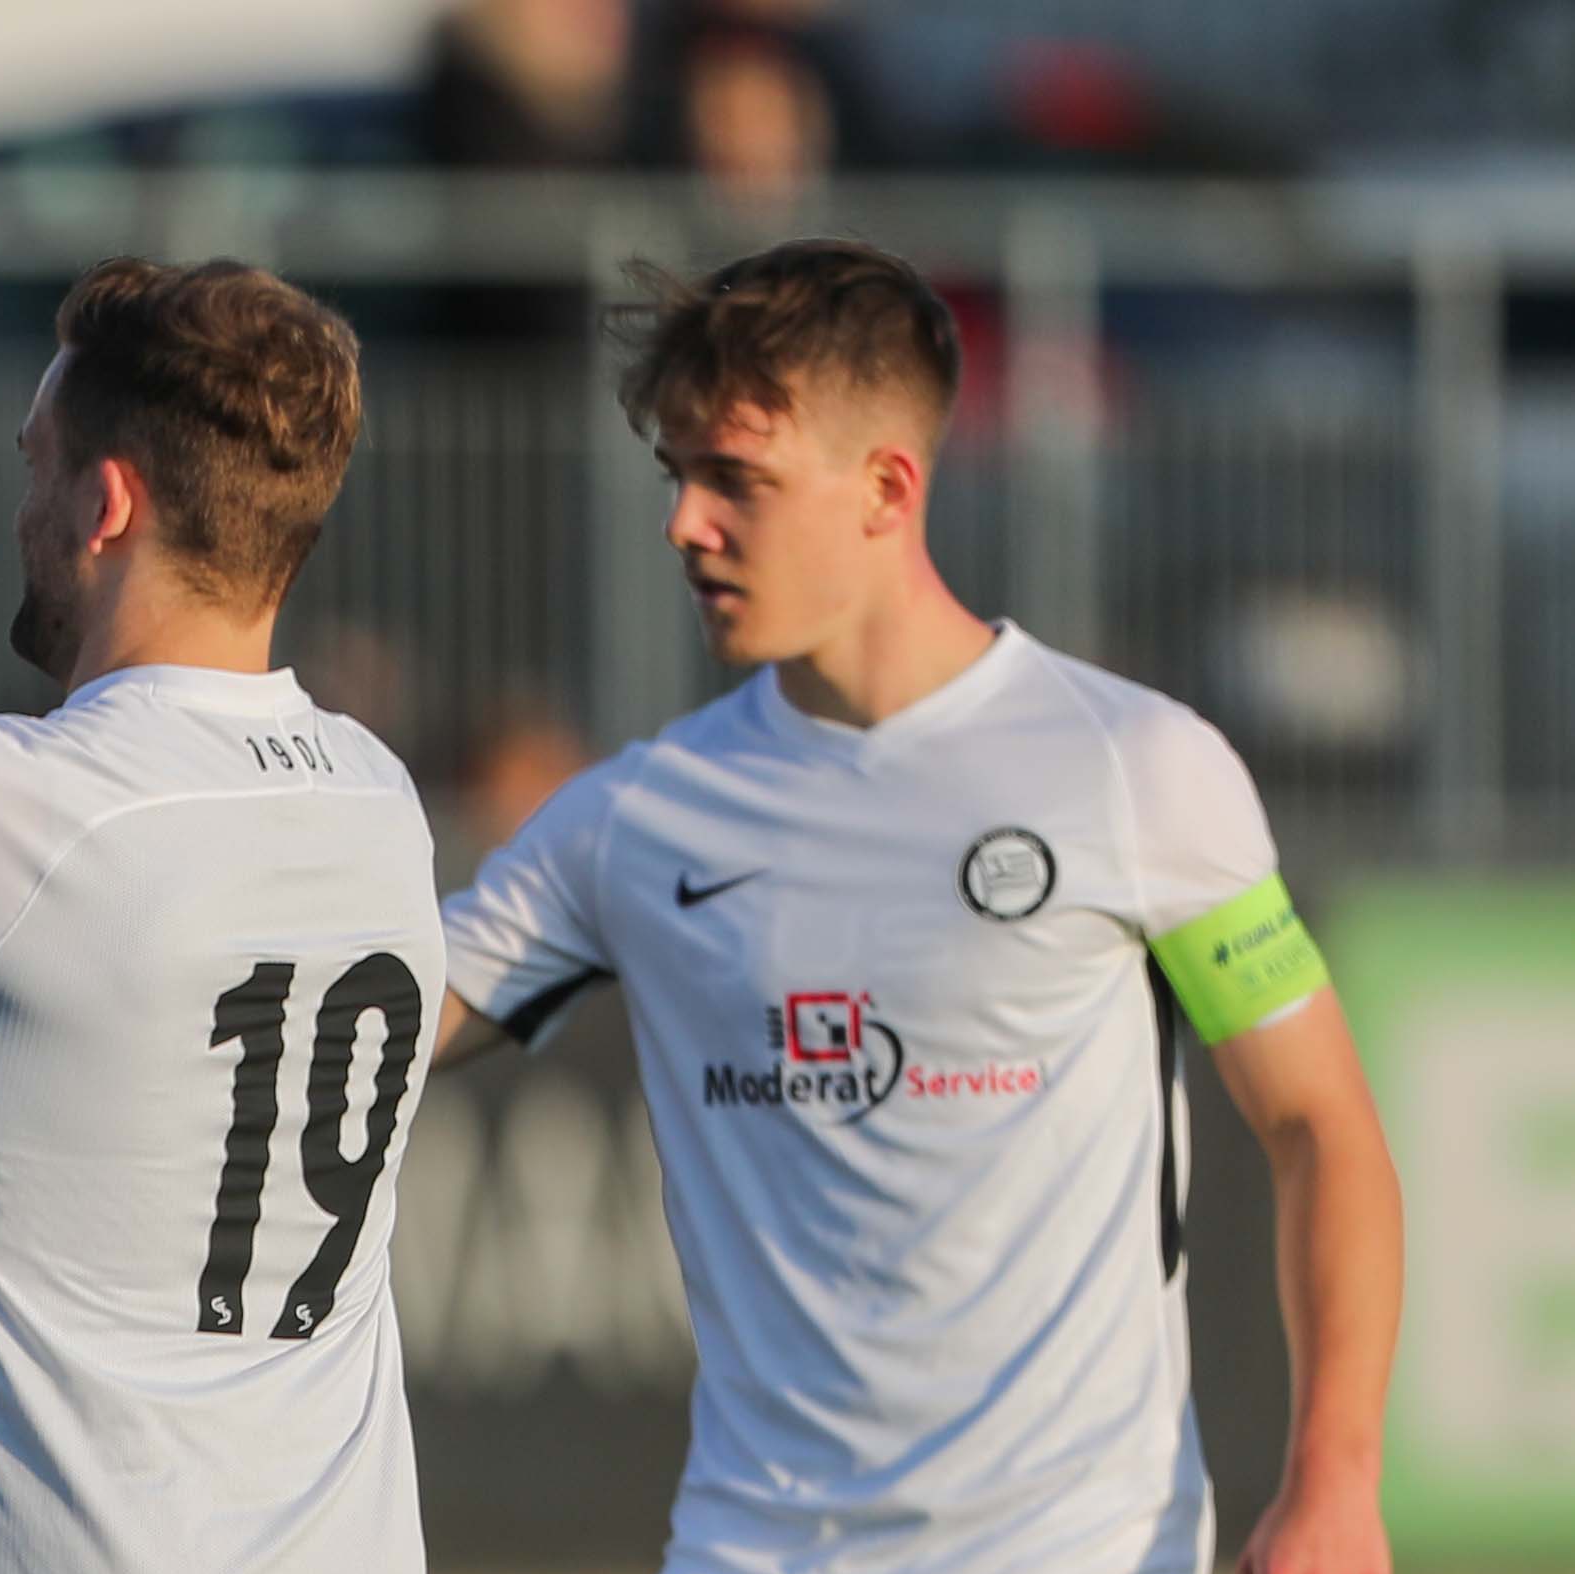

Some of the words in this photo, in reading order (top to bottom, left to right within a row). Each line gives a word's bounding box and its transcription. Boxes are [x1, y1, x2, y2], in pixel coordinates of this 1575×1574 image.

[197, 953, 422, 1338] 19
[705, 1062, 886, 1107] Moderat
[906, 1063, 1039, 1097] Service
